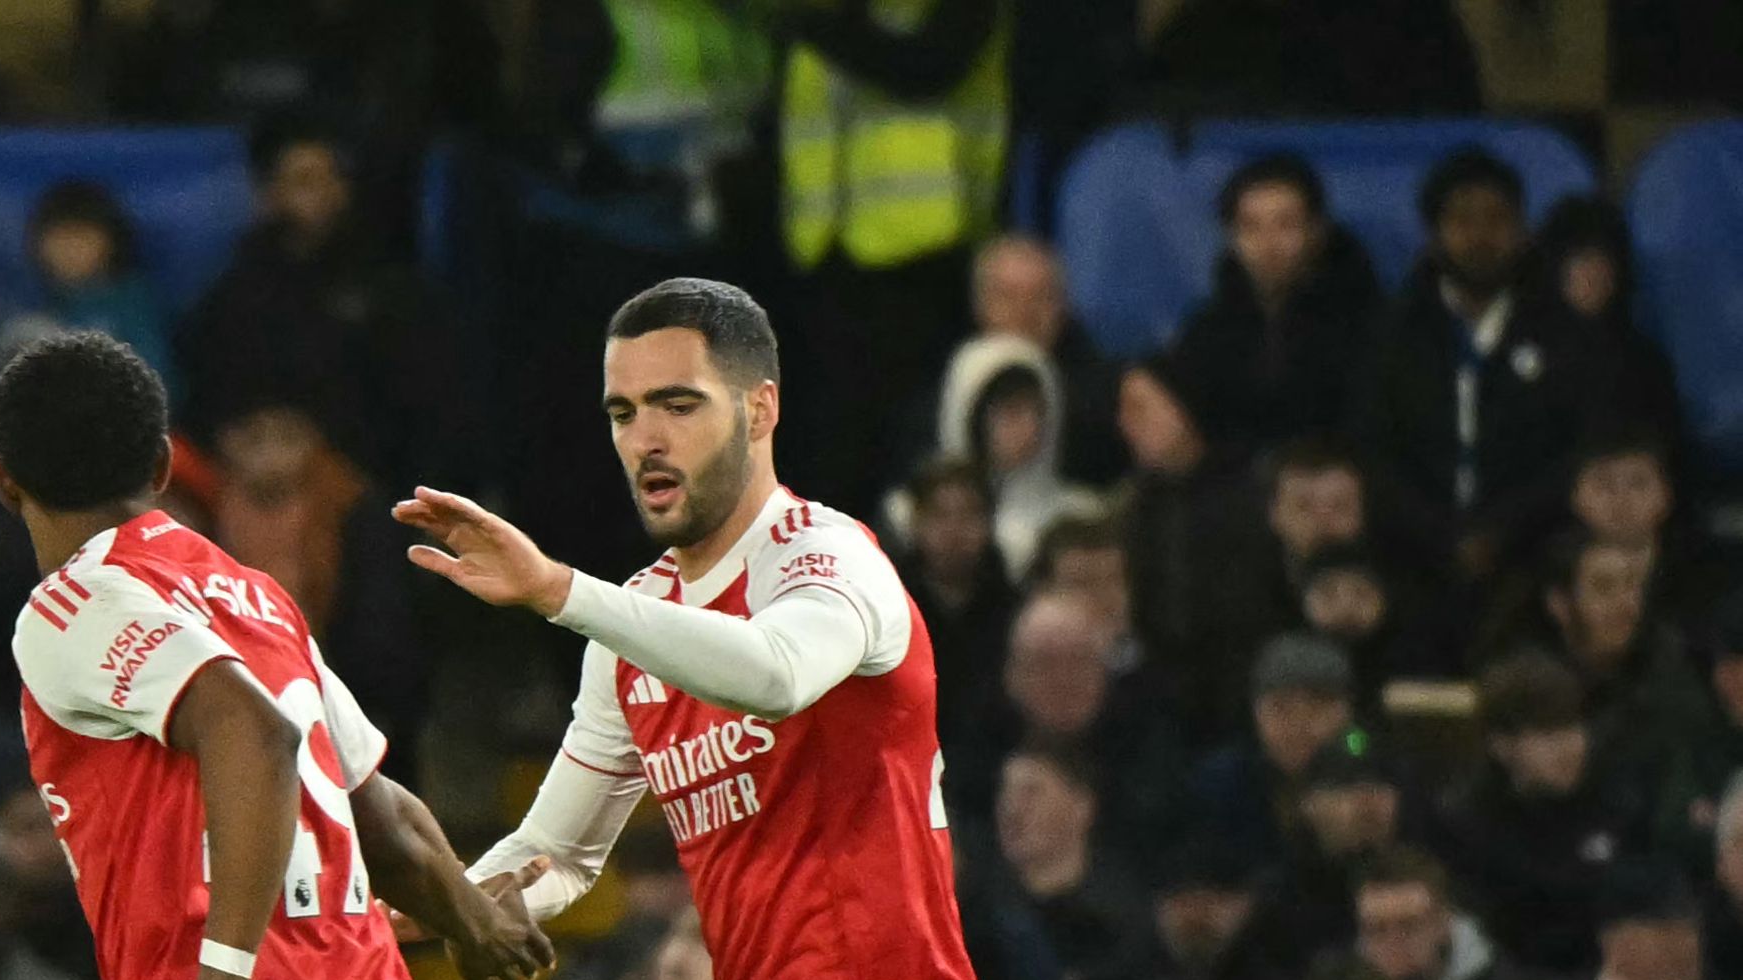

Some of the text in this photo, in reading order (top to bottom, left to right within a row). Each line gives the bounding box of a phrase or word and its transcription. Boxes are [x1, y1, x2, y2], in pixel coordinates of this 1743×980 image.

[779, 552, 839, 574] VISIT
[99, 619, 145, 671] VISIT
[110, 621, 184, 708] RWANDA
[641, 713, 776, 795] mirates
[690, 772, 761, 836] BETTER
